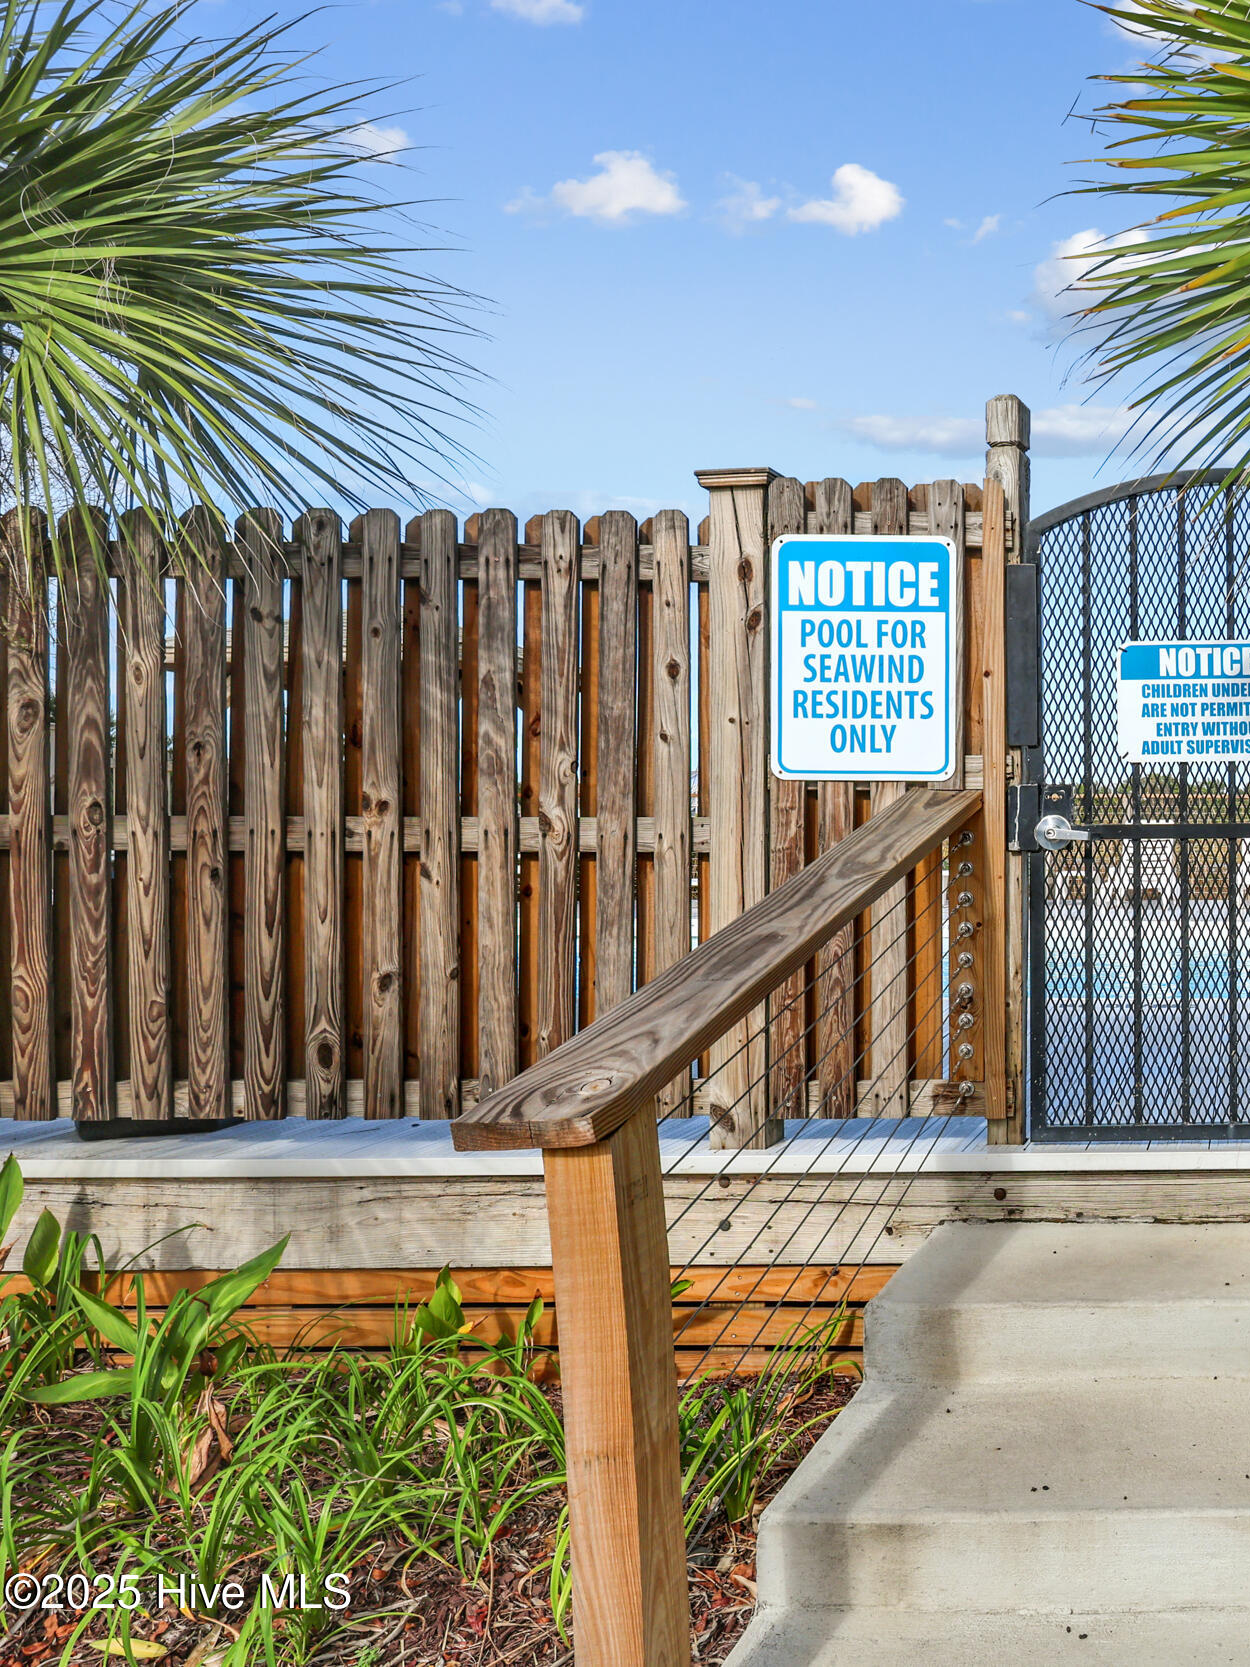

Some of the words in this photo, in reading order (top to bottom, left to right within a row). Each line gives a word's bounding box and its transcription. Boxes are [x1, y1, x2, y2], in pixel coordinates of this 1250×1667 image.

[788, 560, 939, 607] NOTICE
[800, 619, 868, 648] POOL
[877, 620, 926, 649] FOR
[803, 654, 924, 683] SEAWIND
[793, 690, 934, 719] RESIDENTS
[1142, 683, 1208, 698] CHILDREN
[1141, 703, 1167, 718] ARE
[1171, 702, 1197, 717] NOT
[830, 724, 896, 753] ONLY
[1156, 722, 1198, 737] ENTRY
[1142, 740, 1183, 755] ADULT
